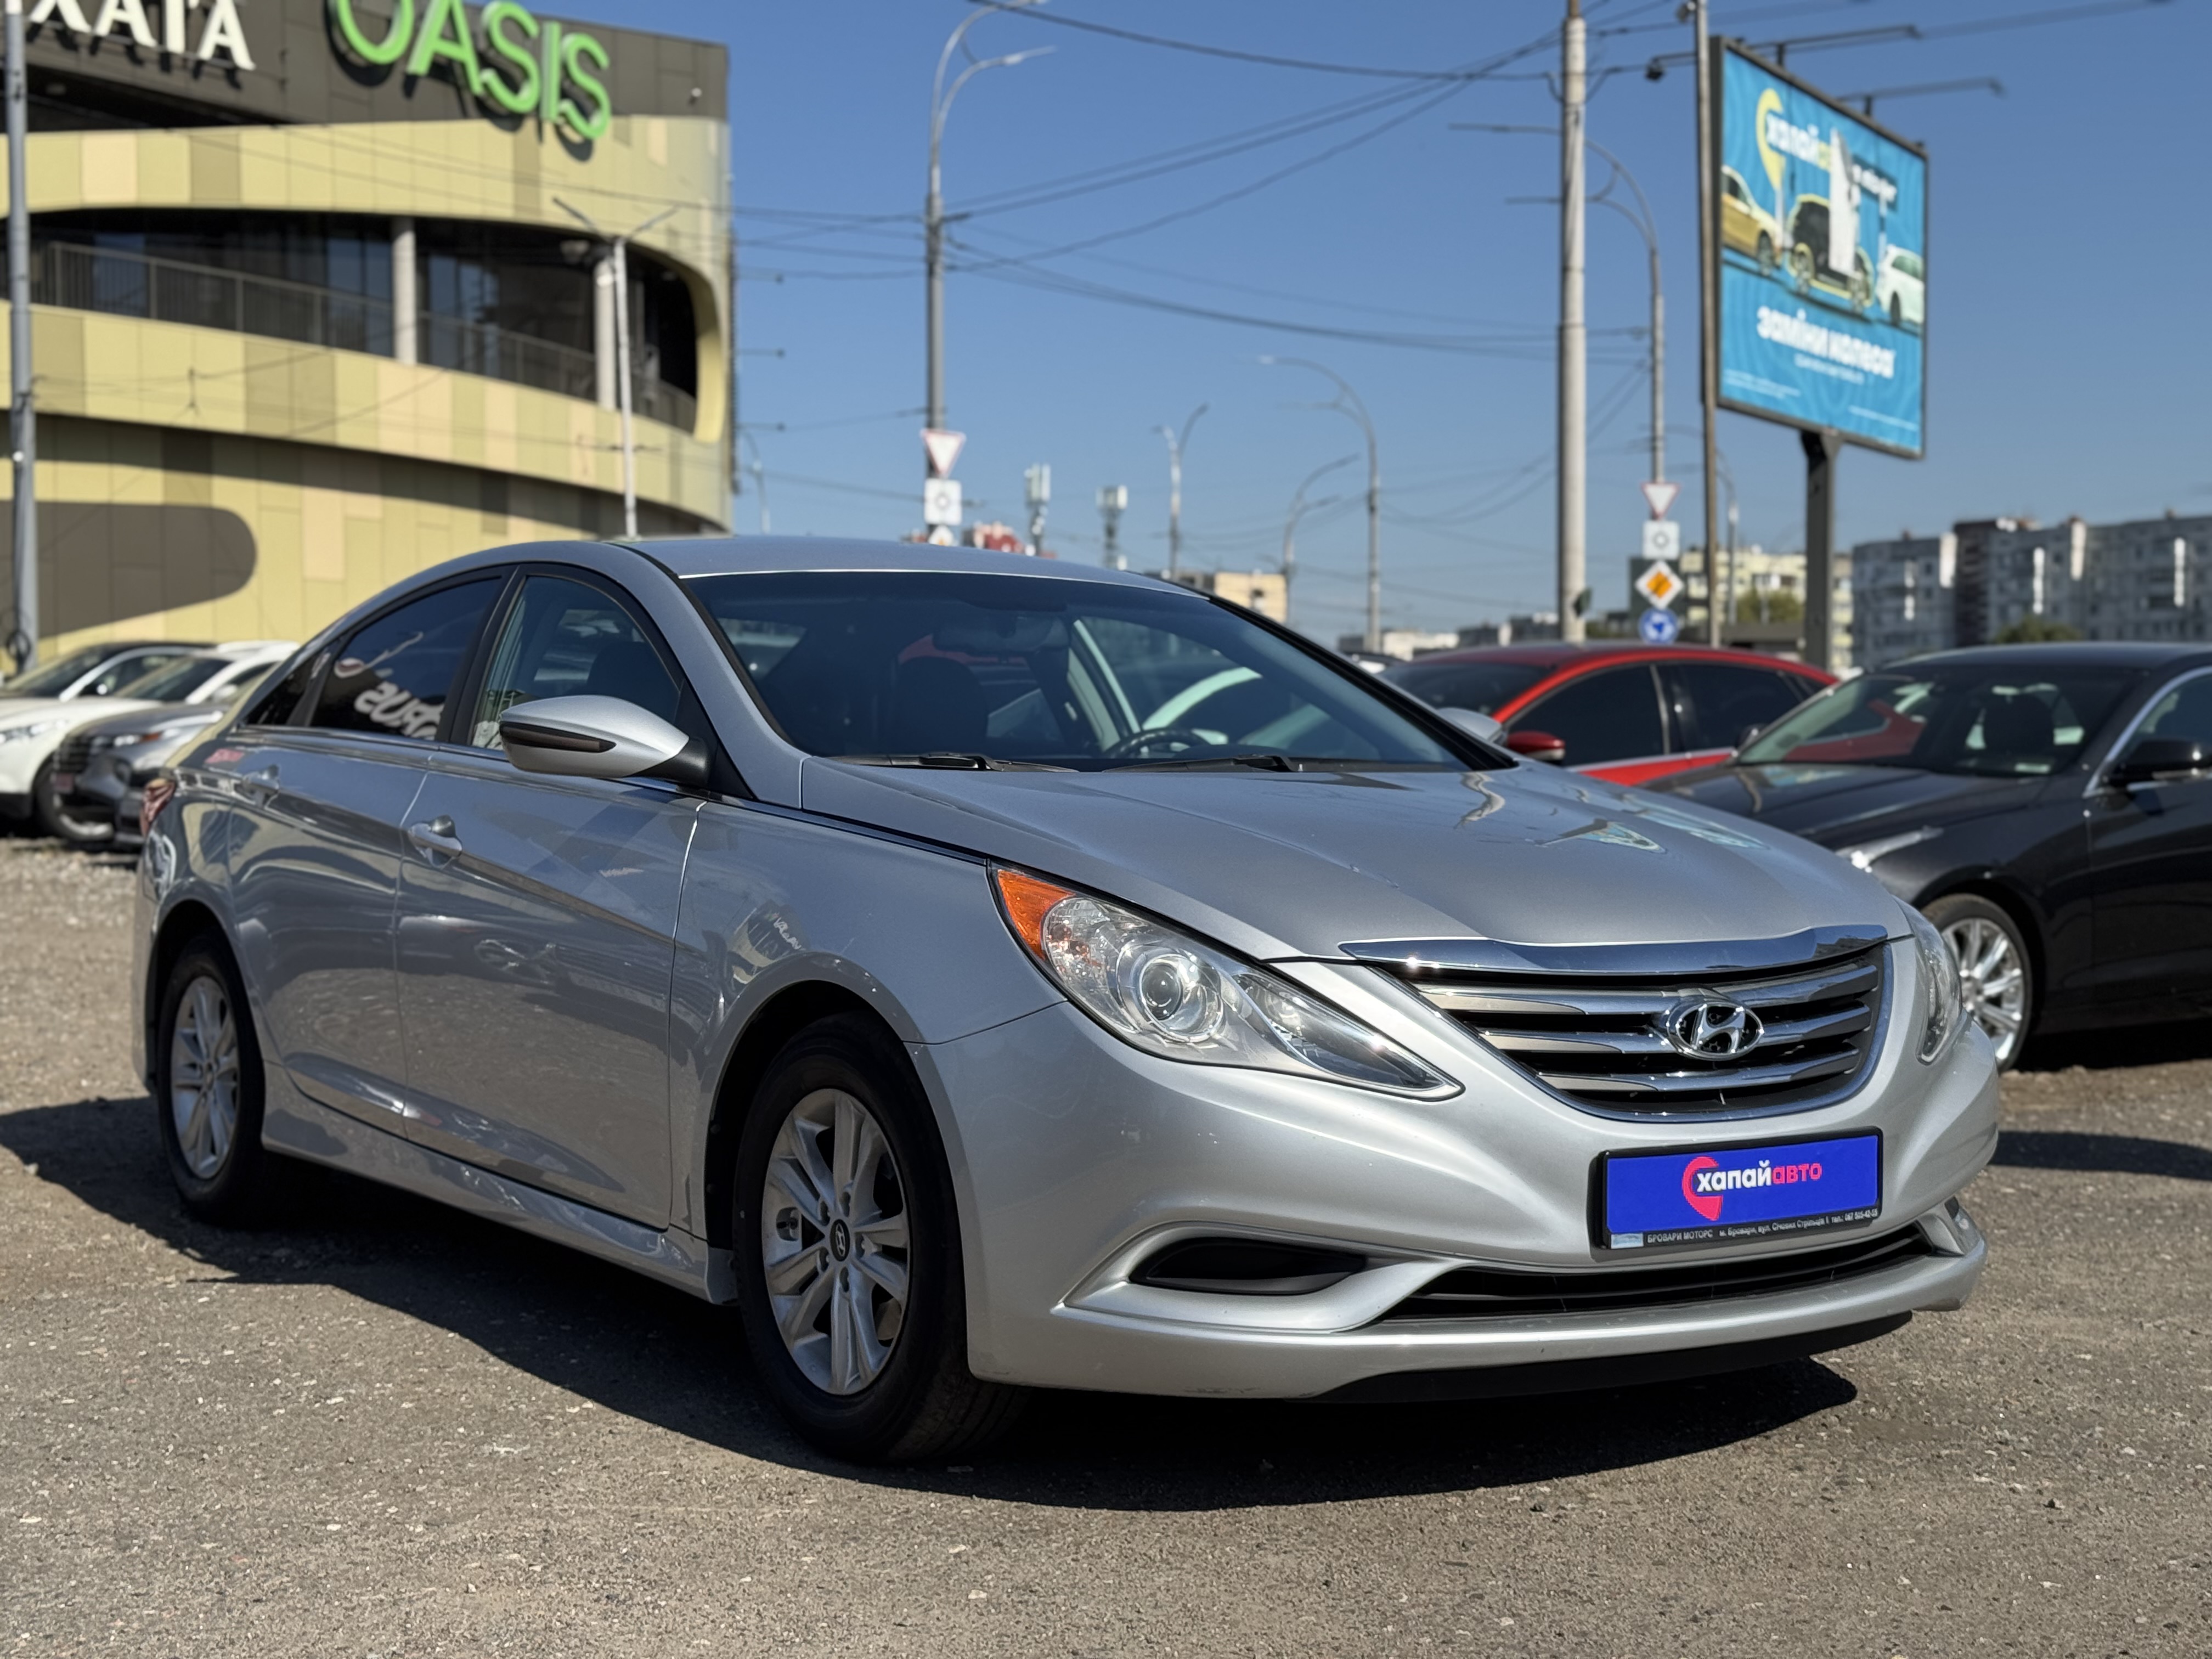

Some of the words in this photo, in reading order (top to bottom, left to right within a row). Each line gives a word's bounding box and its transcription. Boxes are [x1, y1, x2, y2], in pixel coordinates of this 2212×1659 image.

[335, 0, 612, 139] OASIS
[1647, 1232, 1682, 1243] БРОВАРИ
[1683, 1229, 1713, 1240] МОТОРС
